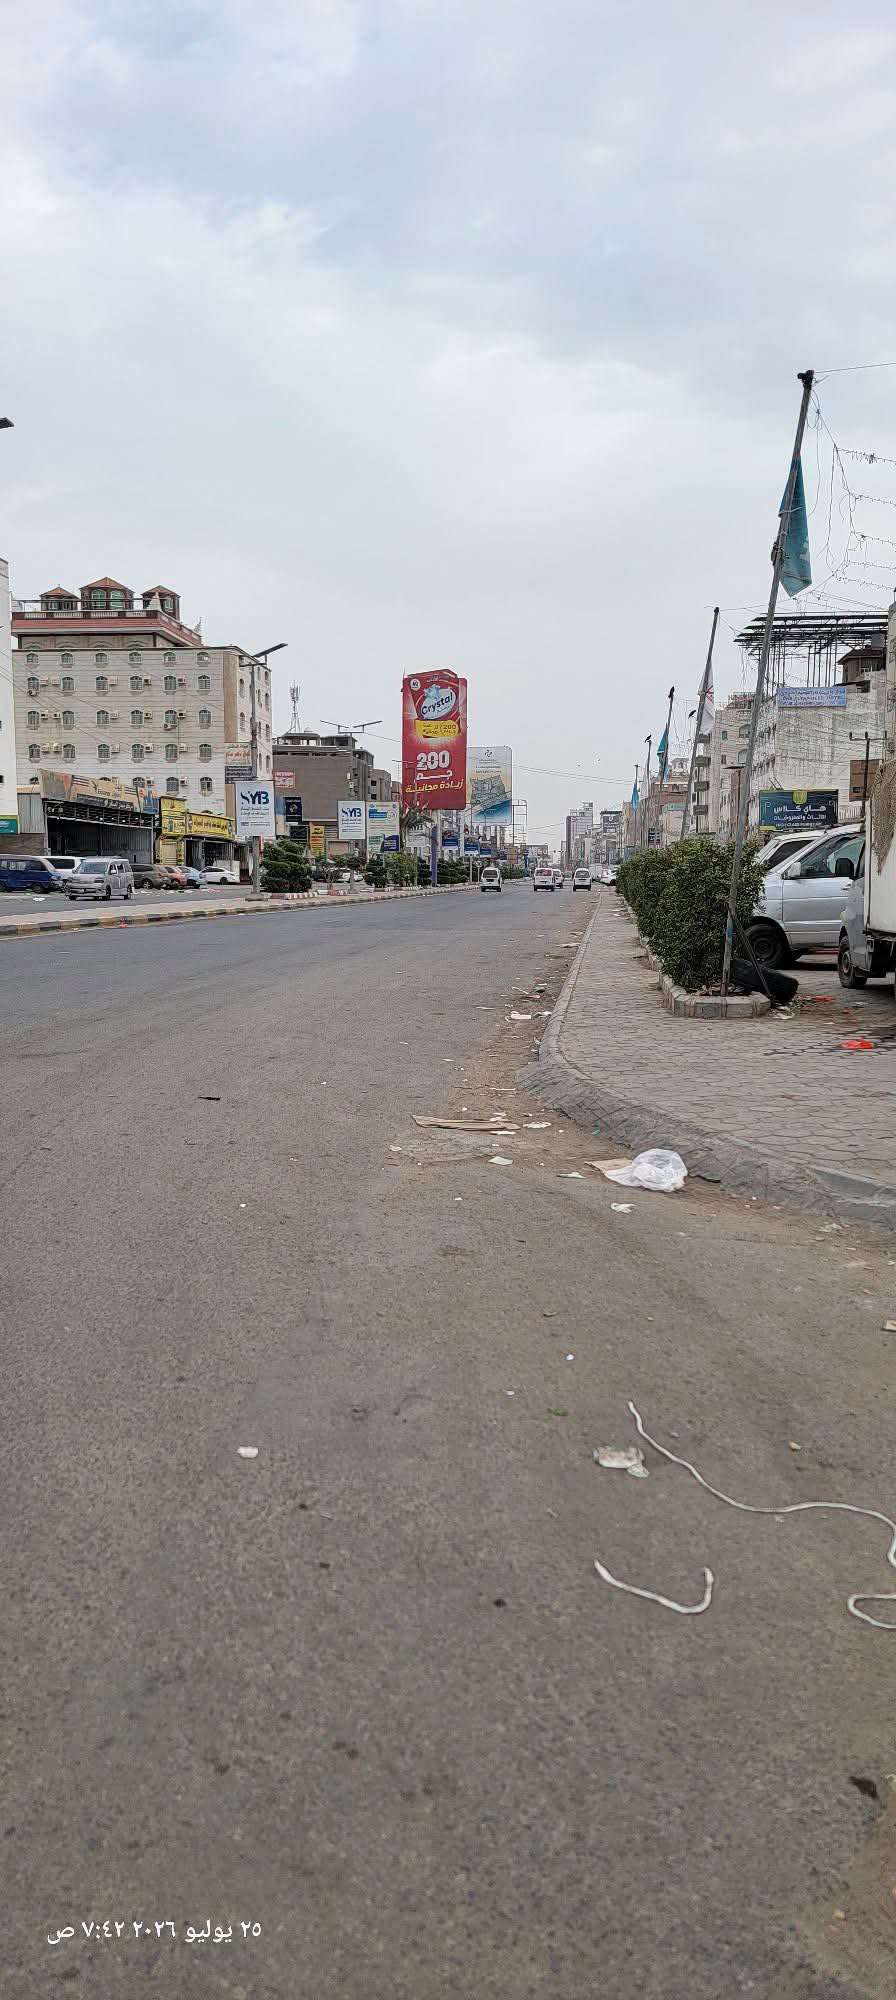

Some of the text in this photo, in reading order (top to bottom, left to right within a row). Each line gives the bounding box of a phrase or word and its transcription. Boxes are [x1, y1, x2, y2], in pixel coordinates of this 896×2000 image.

[421, 692, 453, 715] Crystal
[416, 750, 450, 771] 200
[440, 779, 464, 790] زيادة
[240, 791, 270, 805] SYB
[341, 807, 362, 817] SYB
[773, 804, 802, 814] كلاس
